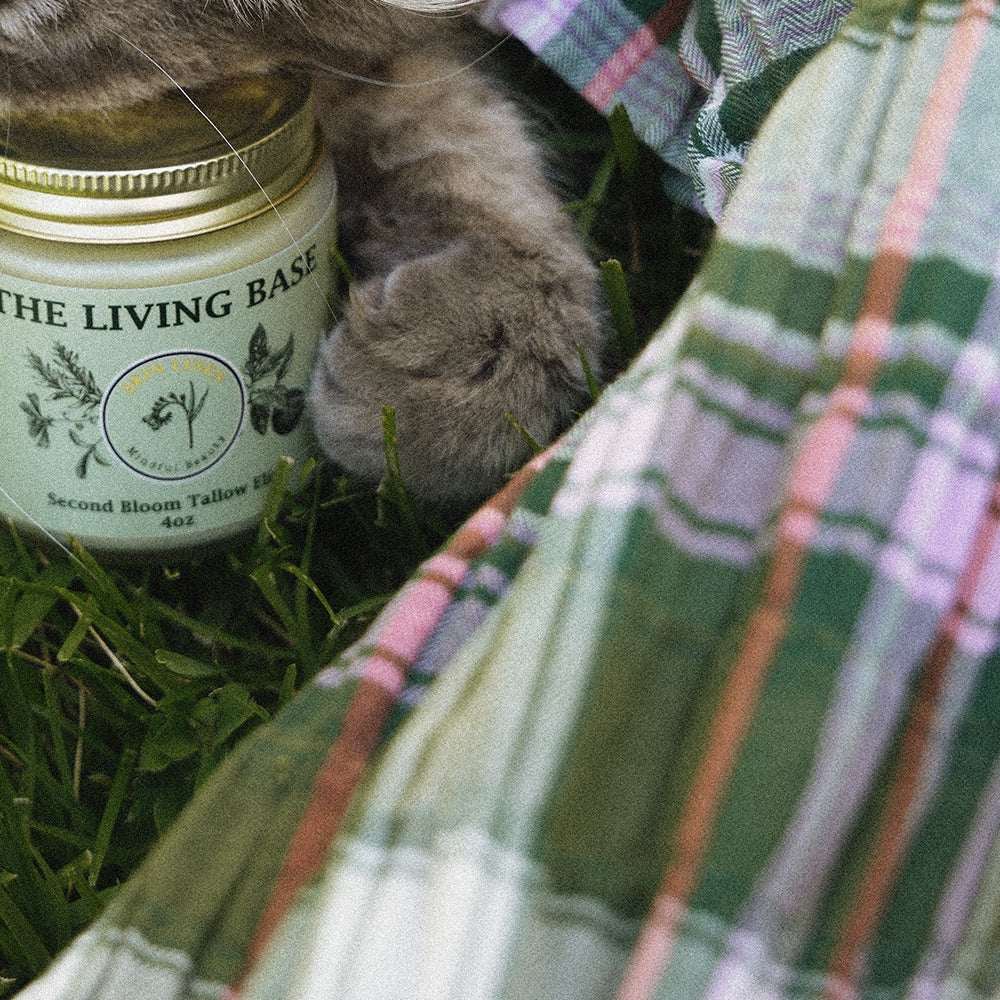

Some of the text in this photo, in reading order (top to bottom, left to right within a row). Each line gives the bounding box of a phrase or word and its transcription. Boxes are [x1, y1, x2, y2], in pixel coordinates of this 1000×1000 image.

[82, 289, 232, 331] LIVING
[246, 244, 318, 308] BASE
[122, 362, 165, 395] SKIN
[47, 491, 113, 513] Second
[120, 499, 181, 514] Bloom
[187, 483, 248, 506] Tallow
[160, 515, 196, 529] 4oz
